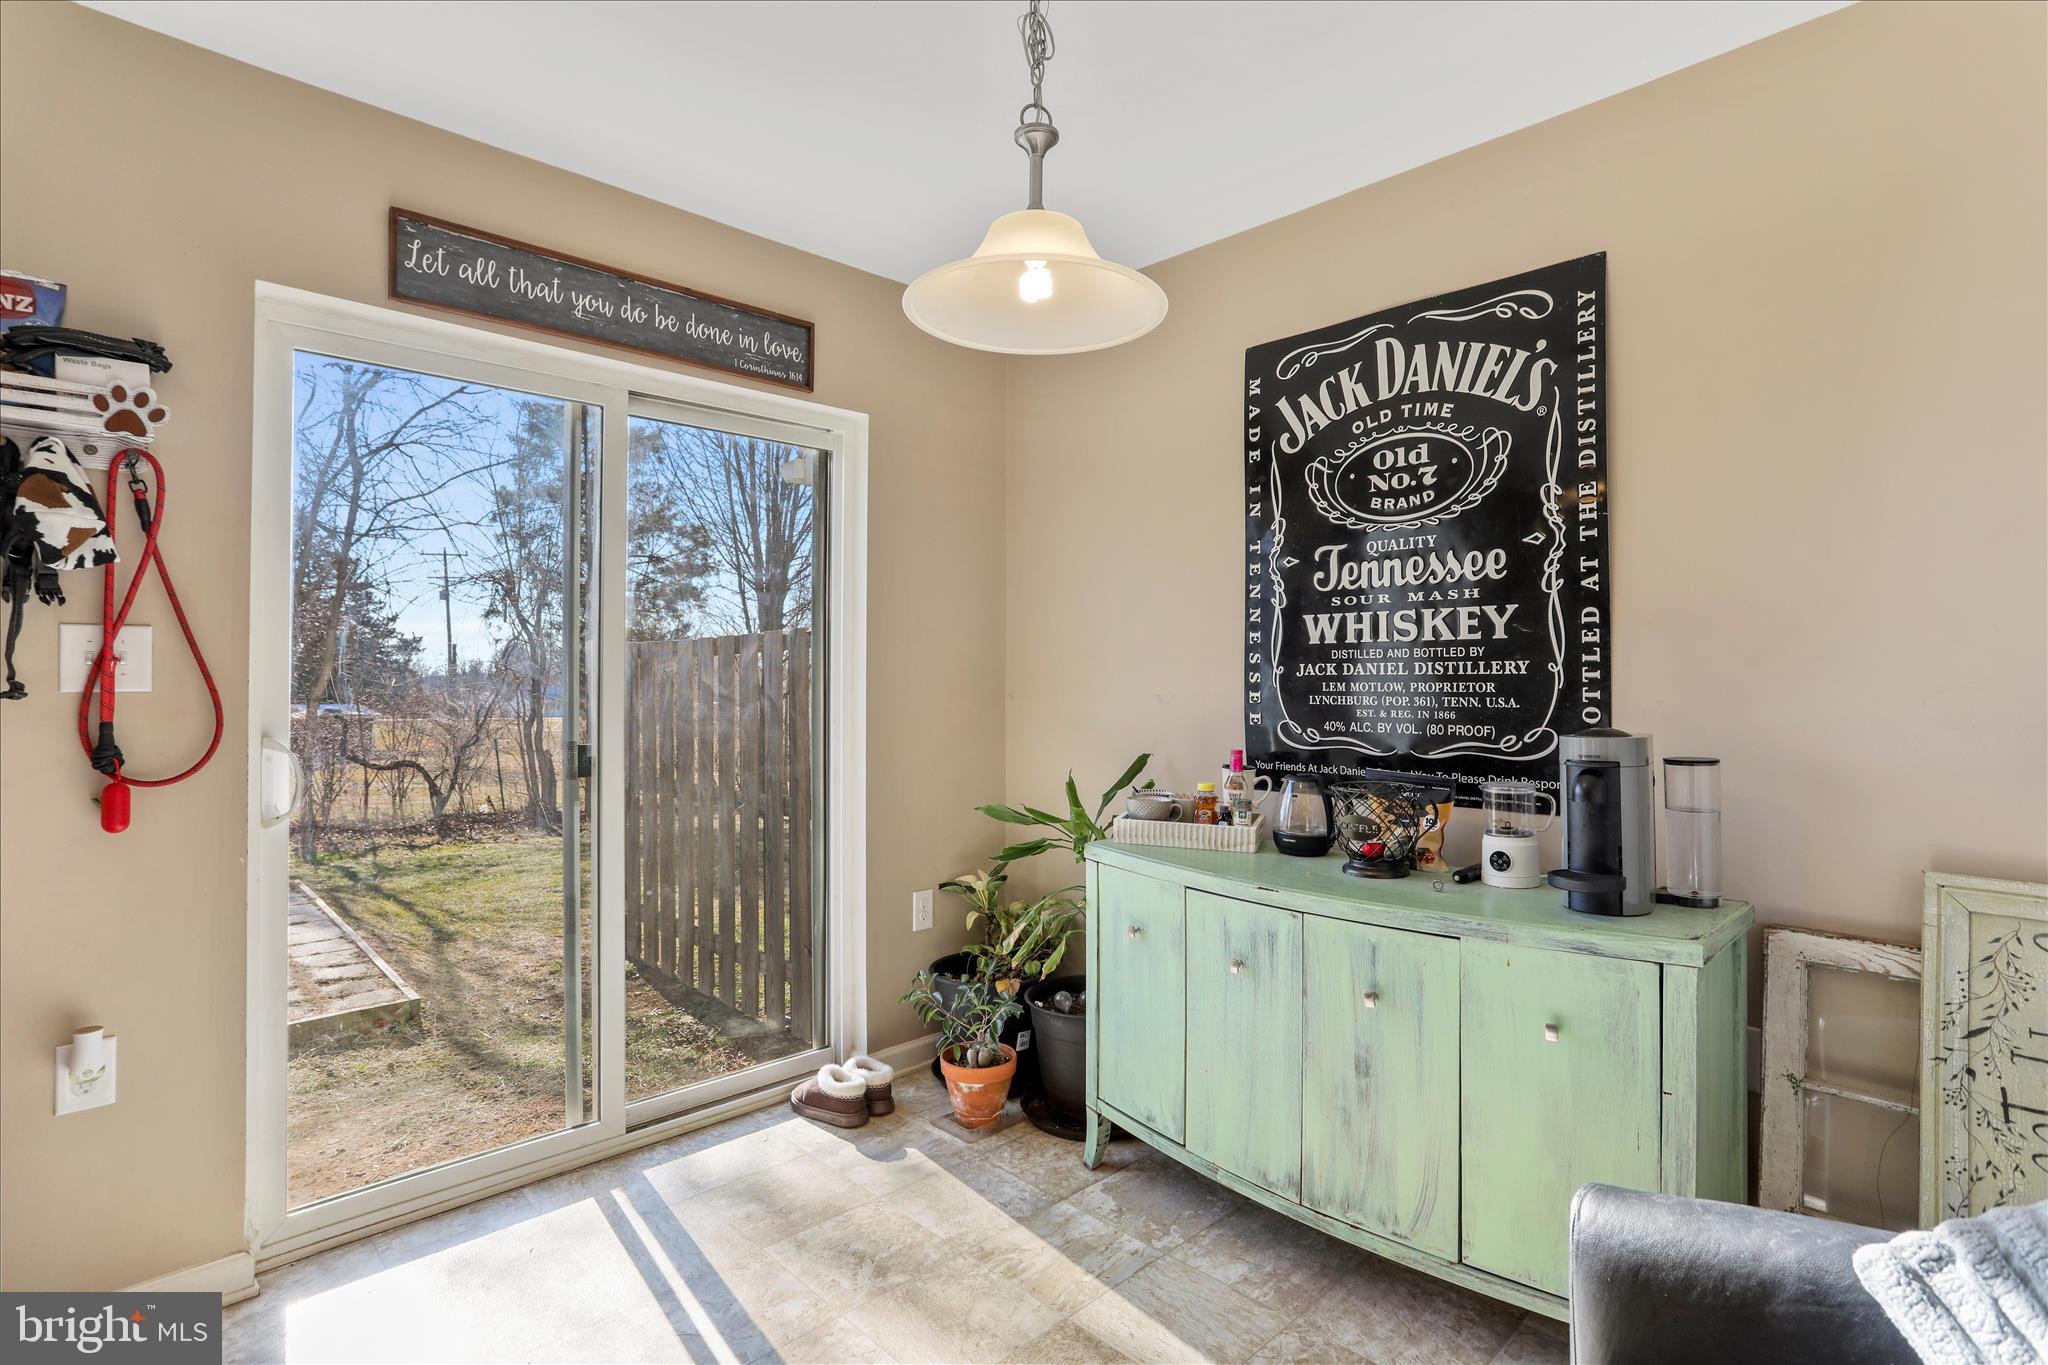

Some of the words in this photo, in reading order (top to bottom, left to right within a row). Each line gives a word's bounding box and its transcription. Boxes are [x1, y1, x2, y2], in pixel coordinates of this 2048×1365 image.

[404, 239, 450, 276] Let
[459, 257, 500, 288] all
[509, 266, 563, 304] that
[571, 291, 613, 318] you
[621, 296, 648, 323] do
[655, 303, 679, 332] be
[686, 313, 733, 345] done
[739, 327, 758, 353] in
[764, 331, 804, 364] love.
[63, 357, 88, 366] Waste
[91, 360, 111, 369] Bags
[739, 359, 787, 379] Corinthians
[1577, 290, 1597, 468] DISTILLERY
[1275, 361, 1374, 454] JACK
[1351, 409, 1392, 434] OLD
[1400, 402, 1455, 418] TIME
[1249, 377, 1261, 464] MADE
[1373, 443, 1430, 470] Old
[1249, 484, 1261, 517] IN
[1370, 490, 1435, 510] BRAND
[1578, 480, 1598, 541] THE
[1366, 534, 1437, 556] QUALITY
[1313, 543, 1508, 592] Tennessee
[1580, 556, 1599, 591] AT
[1331, 594, 1392, 607] SOUR
[1407, 587, 1480, 602] MASH
[1248, 539, 1262, 726] TENNESSEE
[1302, 604, 1519, 645] WHISKEY
[1331, 649, 1383, 659] DISTILLED
[1387, 648, 1410, 658] AND
[1413, 647, 1466, 658] BOTTLED
[1469, 646, 1485, 657] BY
[1296, 663, 1338, 677] JACK
[1342, 662, 1409, 676] DANIEL
[1414, 660, 1530, 675] DISTILLERY
[1322, 682, 1346, 692] LEM
[1350, 682, 1406, 694] MOTLOW,
[1410, 682, 1496, 693] PROPRIETOR
[1309, 695, 1378, 706] LYNCHBURG
[1381, 695, 1411, 707] (POP.
[1413, 696, 1438, 708] 361),
[1441, 696, 1481, 708] TENN.
[1486, 697, 1520, 708] U.S.A.
[1356, 709, 1377, 717] EST.
[1379, 710, 1387, 718] &
[1390, 710, 1414, 719] REG.
[1418, 710, 1430, 719] IN
[1434, 710, 1456, 720] 1866
[1323, 721, 1346, 732] 40%
[1349, 722, 1373, 733] ALC.
[1377, 723, 1392, 733] BY
[1396, 723, 1422, 735] VOL.
[1426, 723, 1444, 738] (80
[1447, 724, 1496, 740] PROOF)
[1255, 760, 1274, 770] Your
[1275, 761, 1306, 772] Friends
[1307, 763, 1318, 773] At
[1319, 764, 1339, 775] Jack
[1451, 772, 1486, 784] Please
